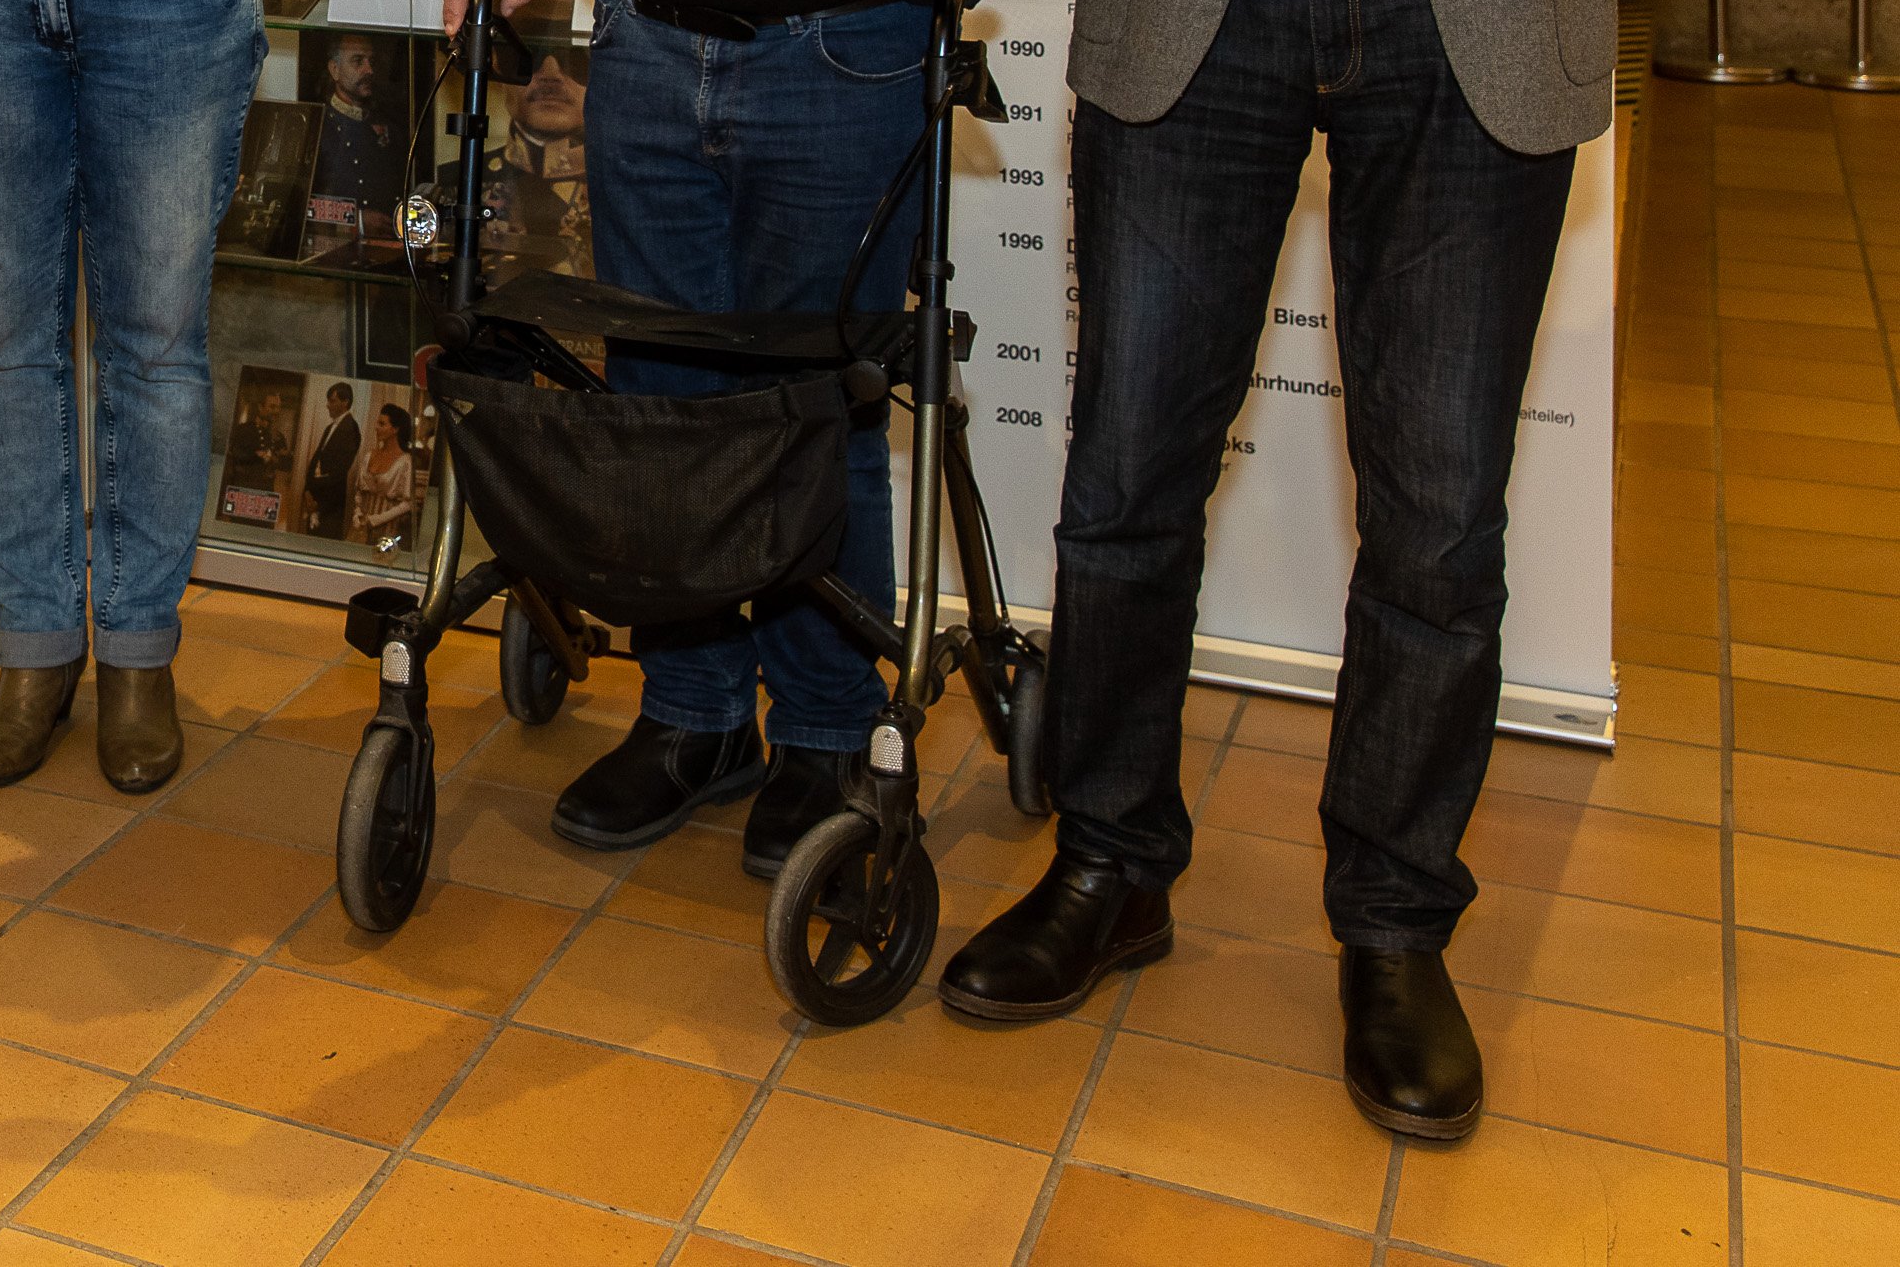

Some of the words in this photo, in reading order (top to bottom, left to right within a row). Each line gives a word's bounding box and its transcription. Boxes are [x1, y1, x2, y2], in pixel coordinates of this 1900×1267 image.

[1000, 40, 1045, 57] 1990
[999, 169, 1044, 186] 1993
[998, 233, 1044, 250] 1996
[1273, 307, 1328, 330] Biest
[997, 344, 1042, 362] 2001
[996, 408, 1043, 427] 2008
